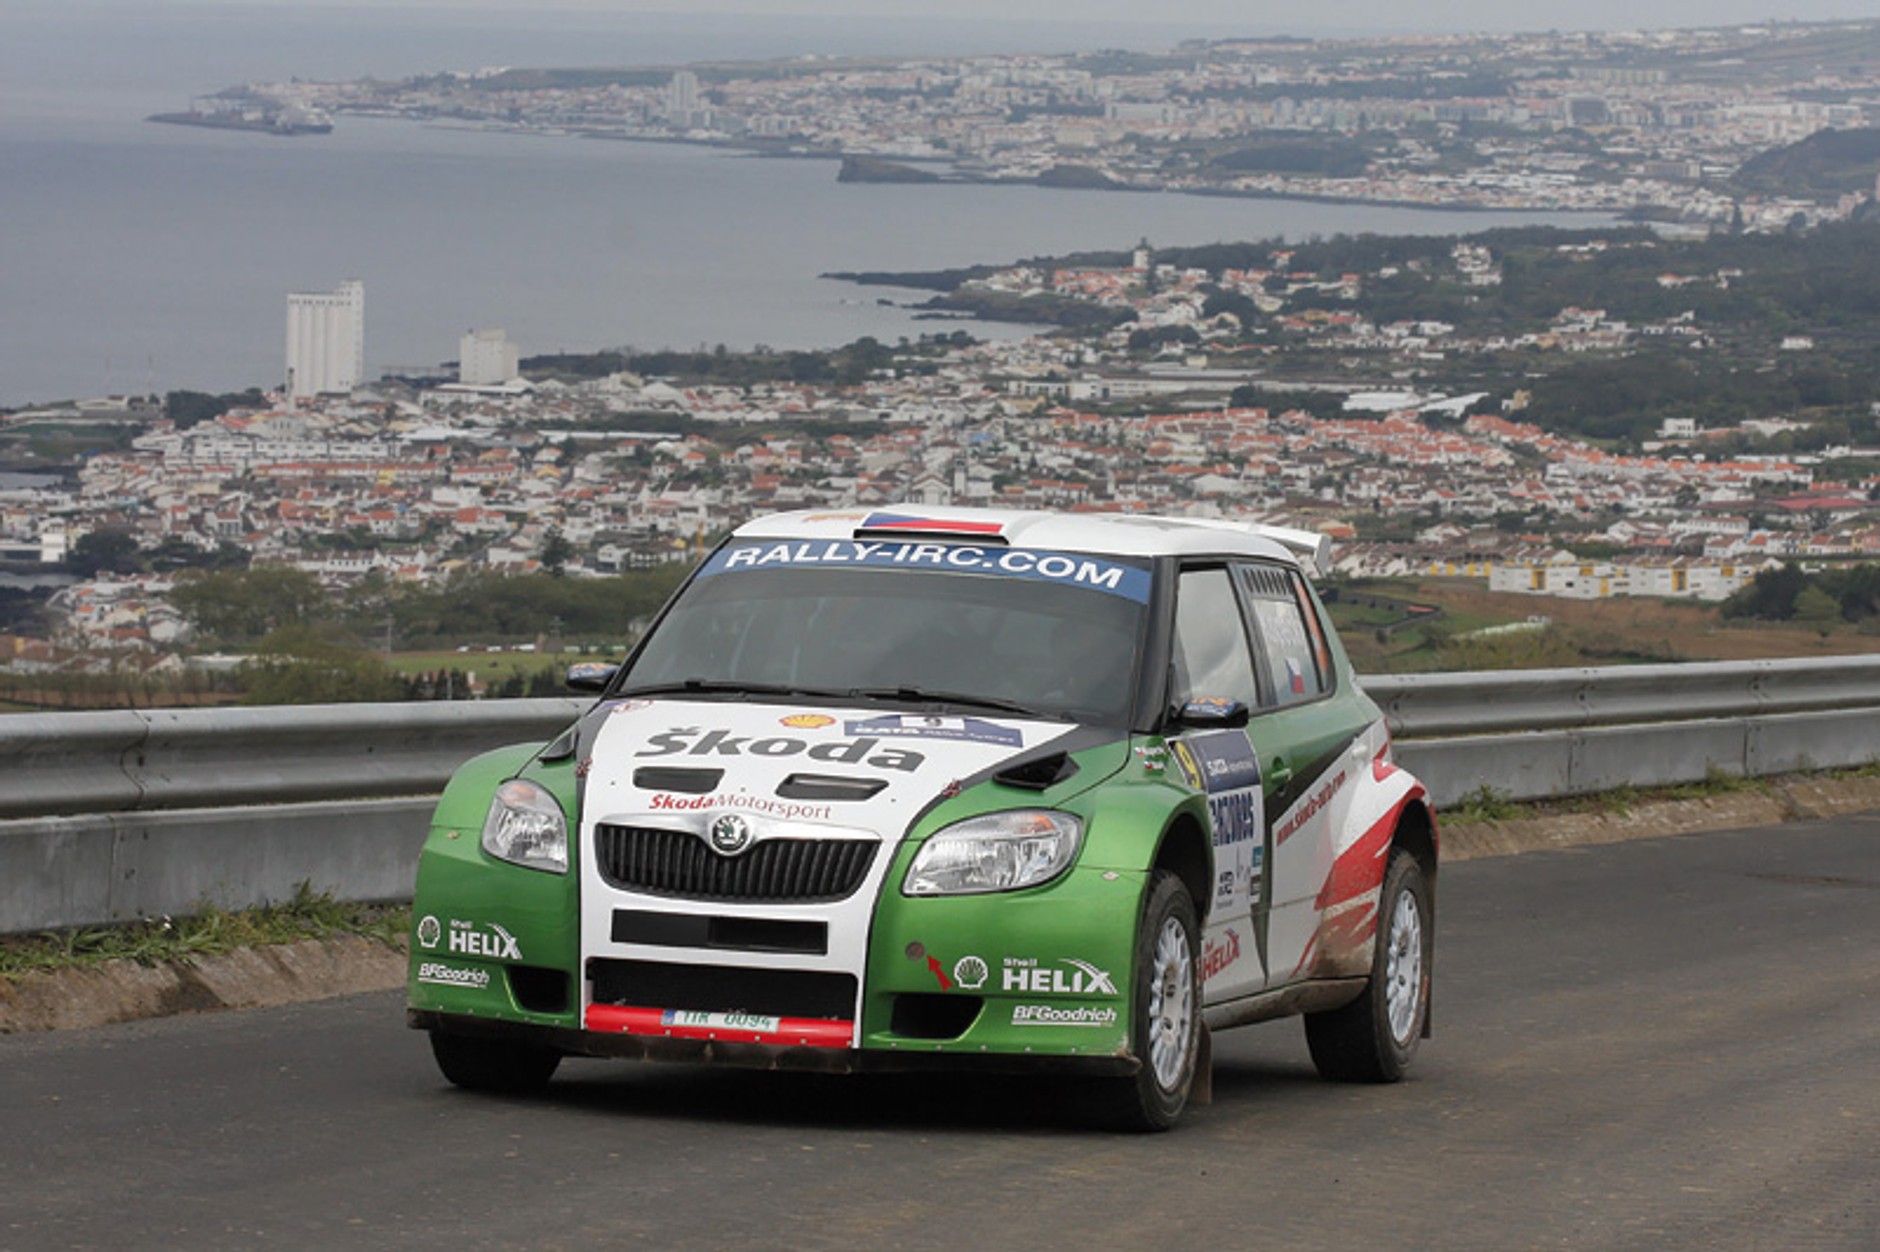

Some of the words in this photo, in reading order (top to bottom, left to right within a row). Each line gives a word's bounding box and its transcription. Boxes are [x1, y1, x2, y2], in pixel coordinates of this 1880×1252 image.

[724, 541, 1125, 590] RALLY-IRC.COM
[634, 725, 927, 772] Škoda
[448, 921, 523, 960] HELIX
[418, 963, 490, 985] BFGoodrich
[1002, 958, 1119, 994] HELIX
[1012, 1004, 1118, 1023] BFGoodrich
